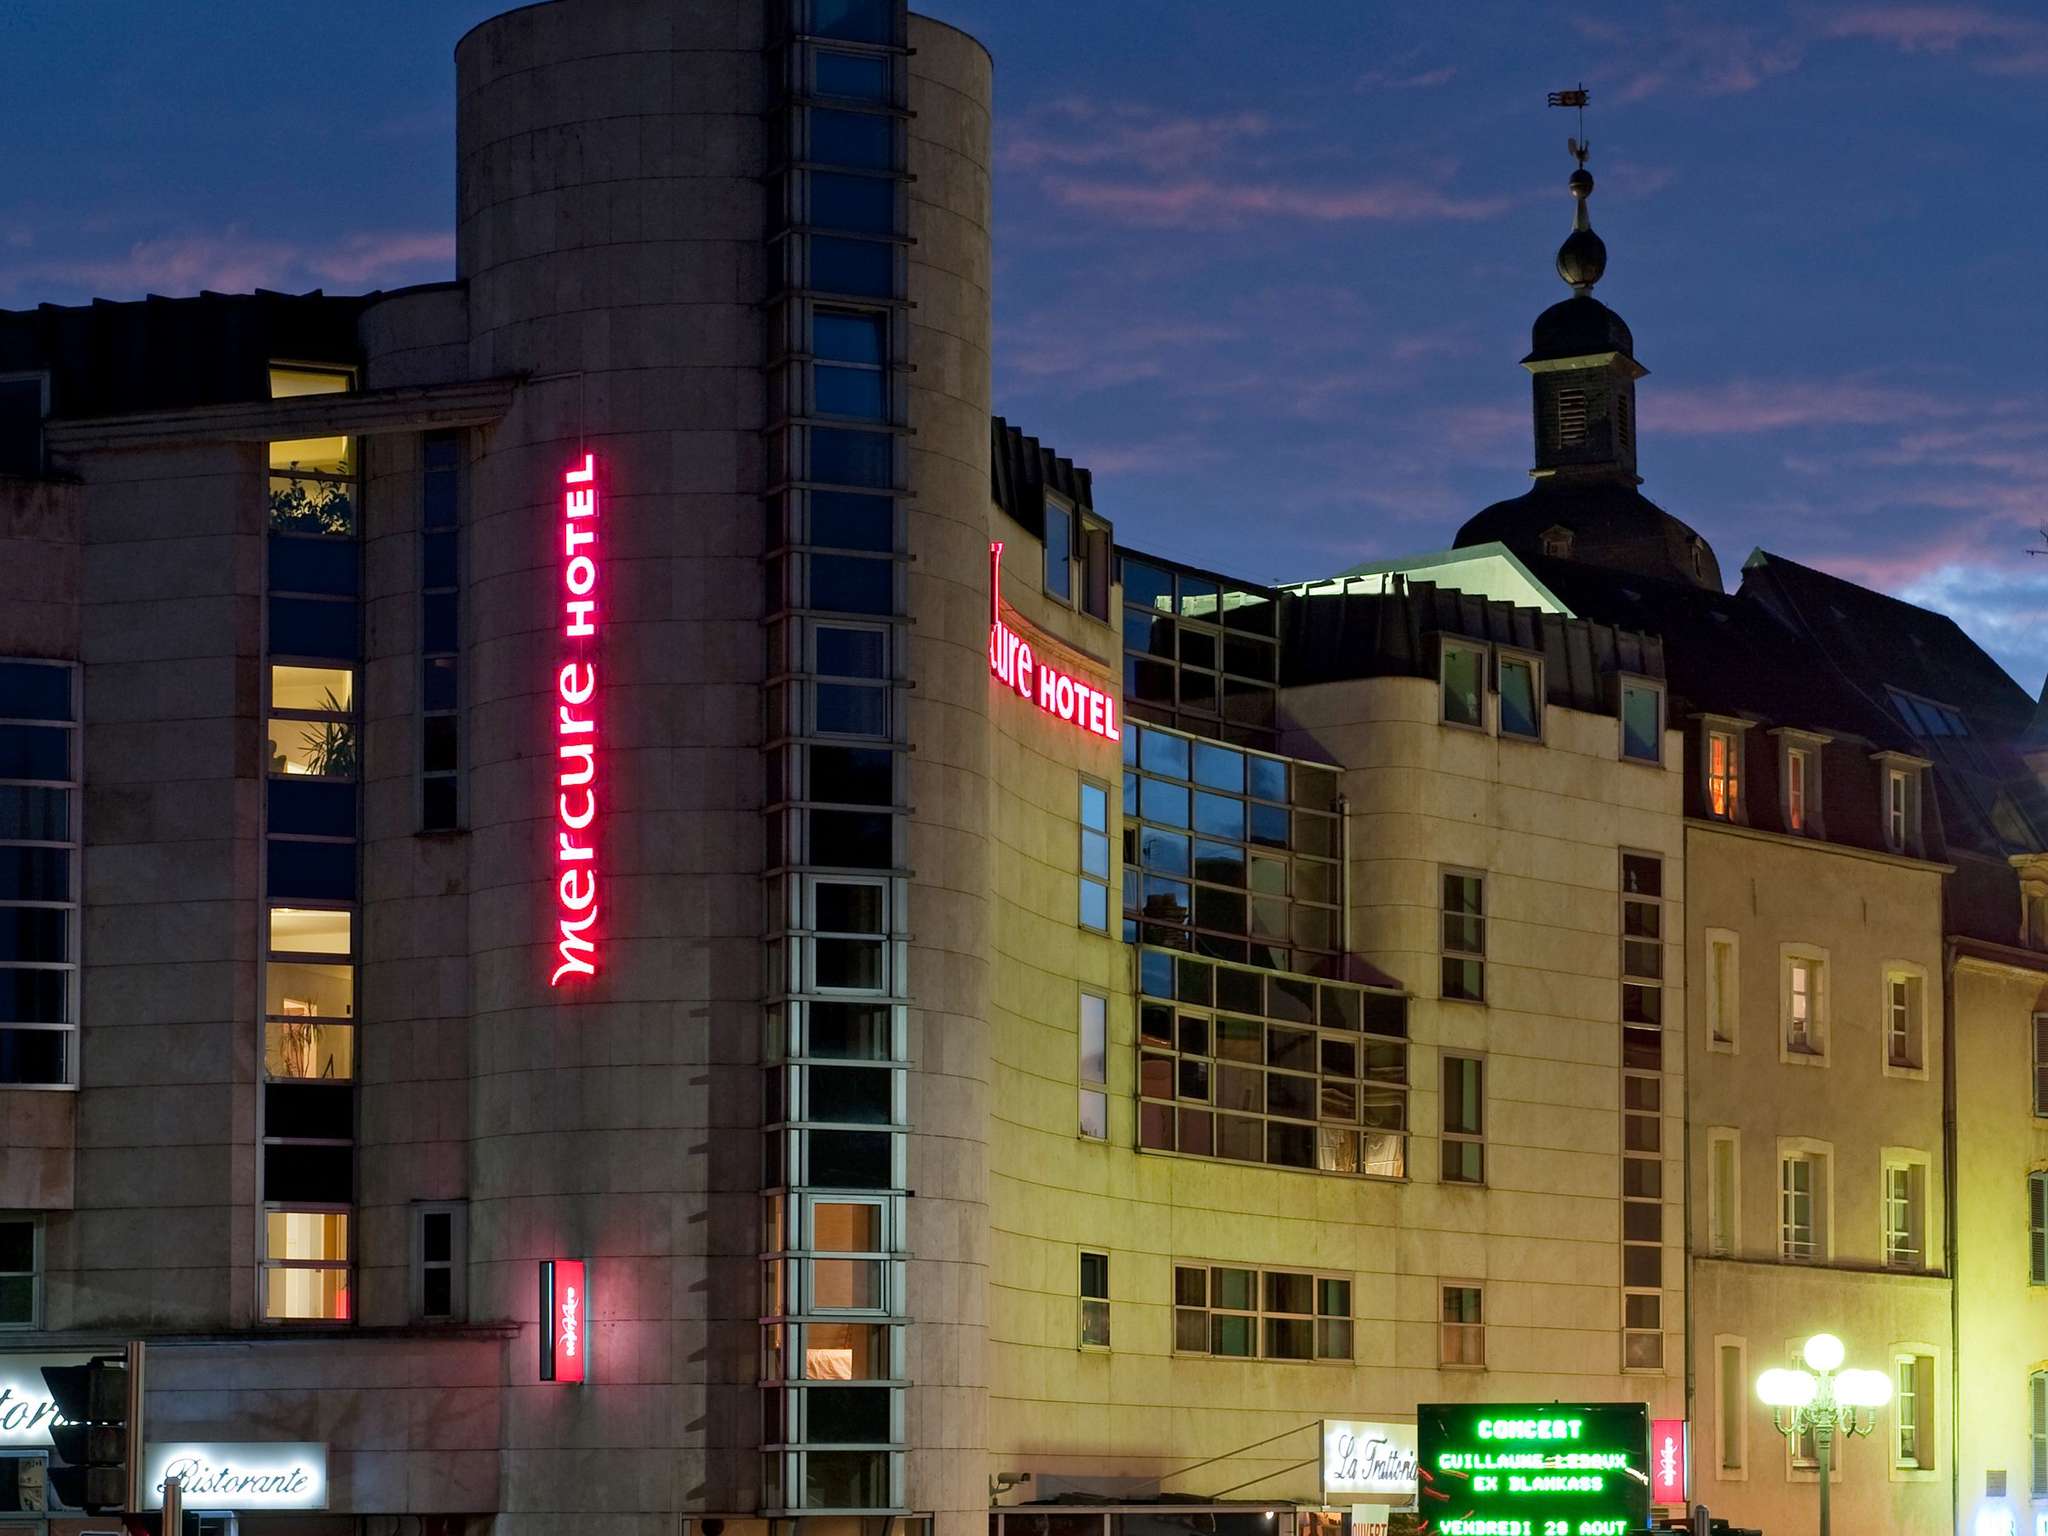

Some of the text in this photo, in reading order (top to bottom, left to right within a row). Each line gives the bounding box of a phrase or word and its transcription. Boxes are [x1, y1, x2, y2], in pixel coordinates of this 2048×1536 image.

[565, 453, 595, 637] HOTEL
[1040, 665, 1120, 741] HOTEL
[1478, 1420, 1582, 1439] CONCERT
[1334, 1434, 1359, 1480] La
[1439, 1453, 1543, 1470] GUILLAUME
[157, 1458, 309, 1494] Ristorante
[1474, 1476, 1498, 1491] EX
[1439, 1520, 1531, 1536] VENDREDI
[1580, 1521, 1627, 1536] AOUT
